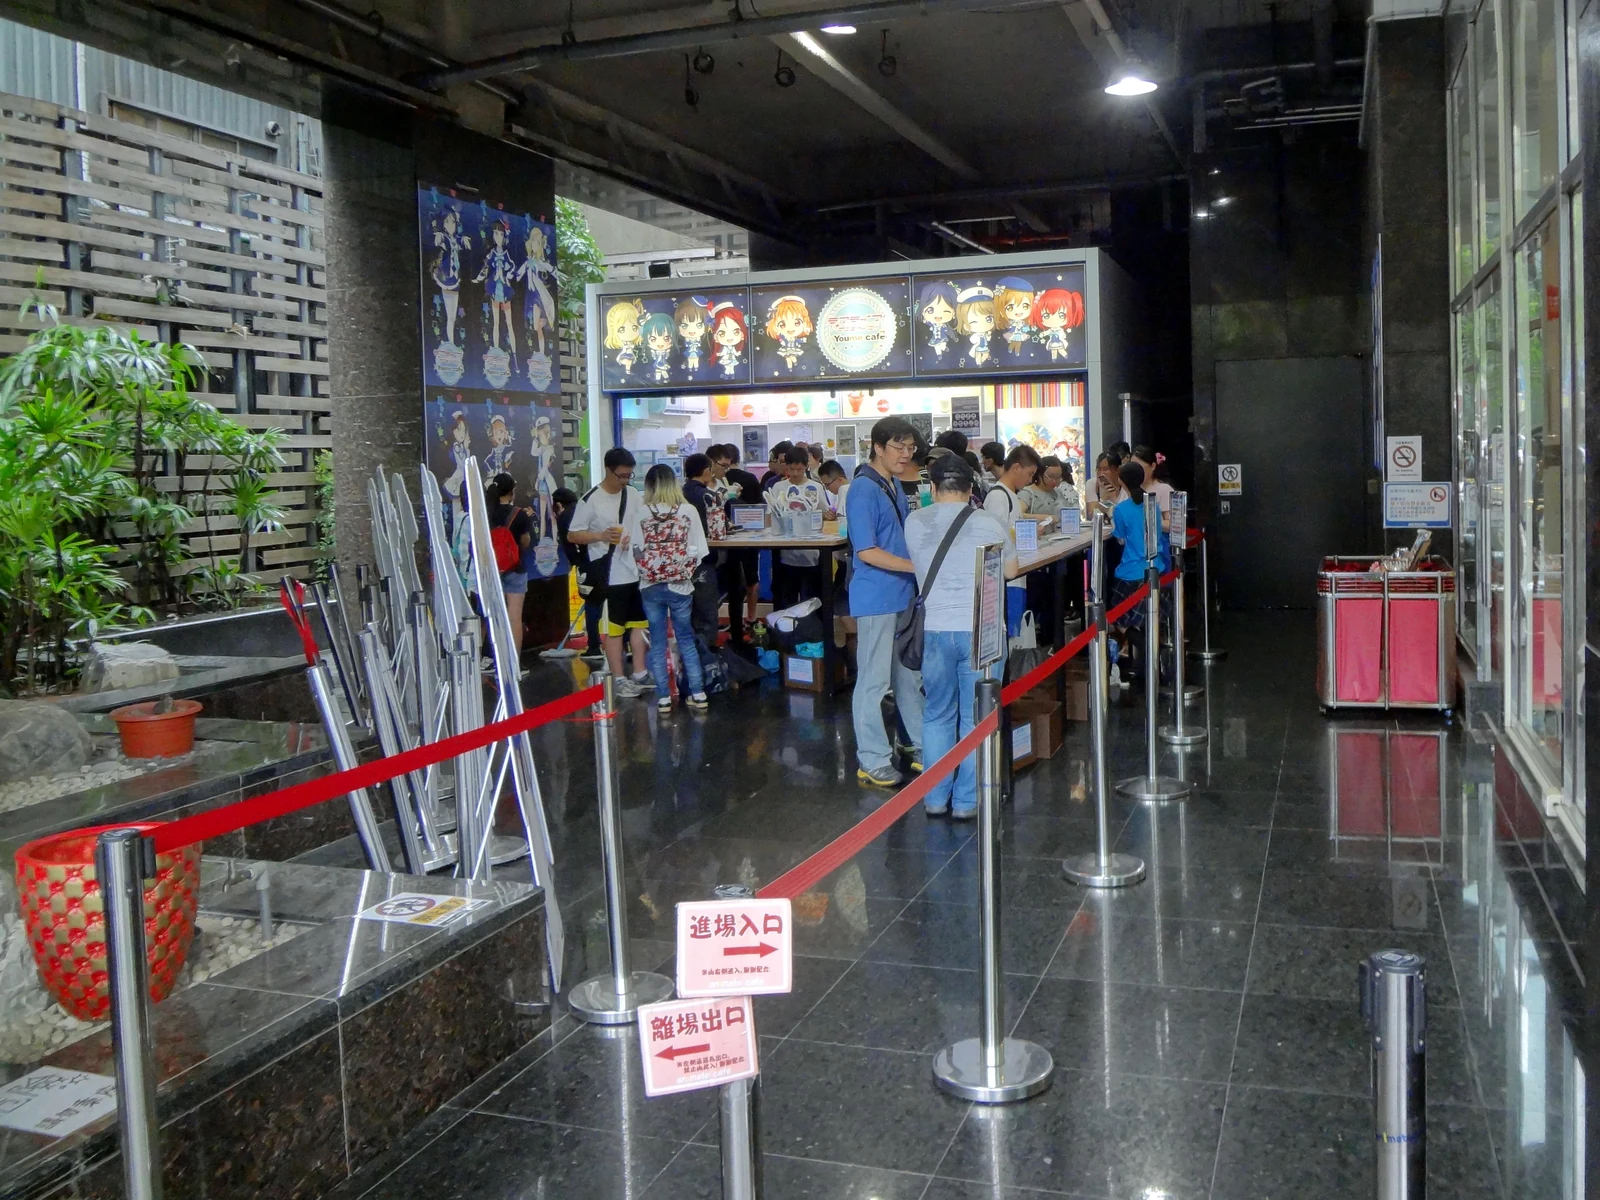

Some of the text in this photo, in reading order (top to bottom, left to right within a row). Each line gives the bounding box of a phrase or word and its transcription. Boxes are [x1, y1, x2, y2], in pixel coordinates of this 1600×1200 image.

[690, 913, 783, 939] 進場入口
[650, 1006, 745, 1042] 離場出口
